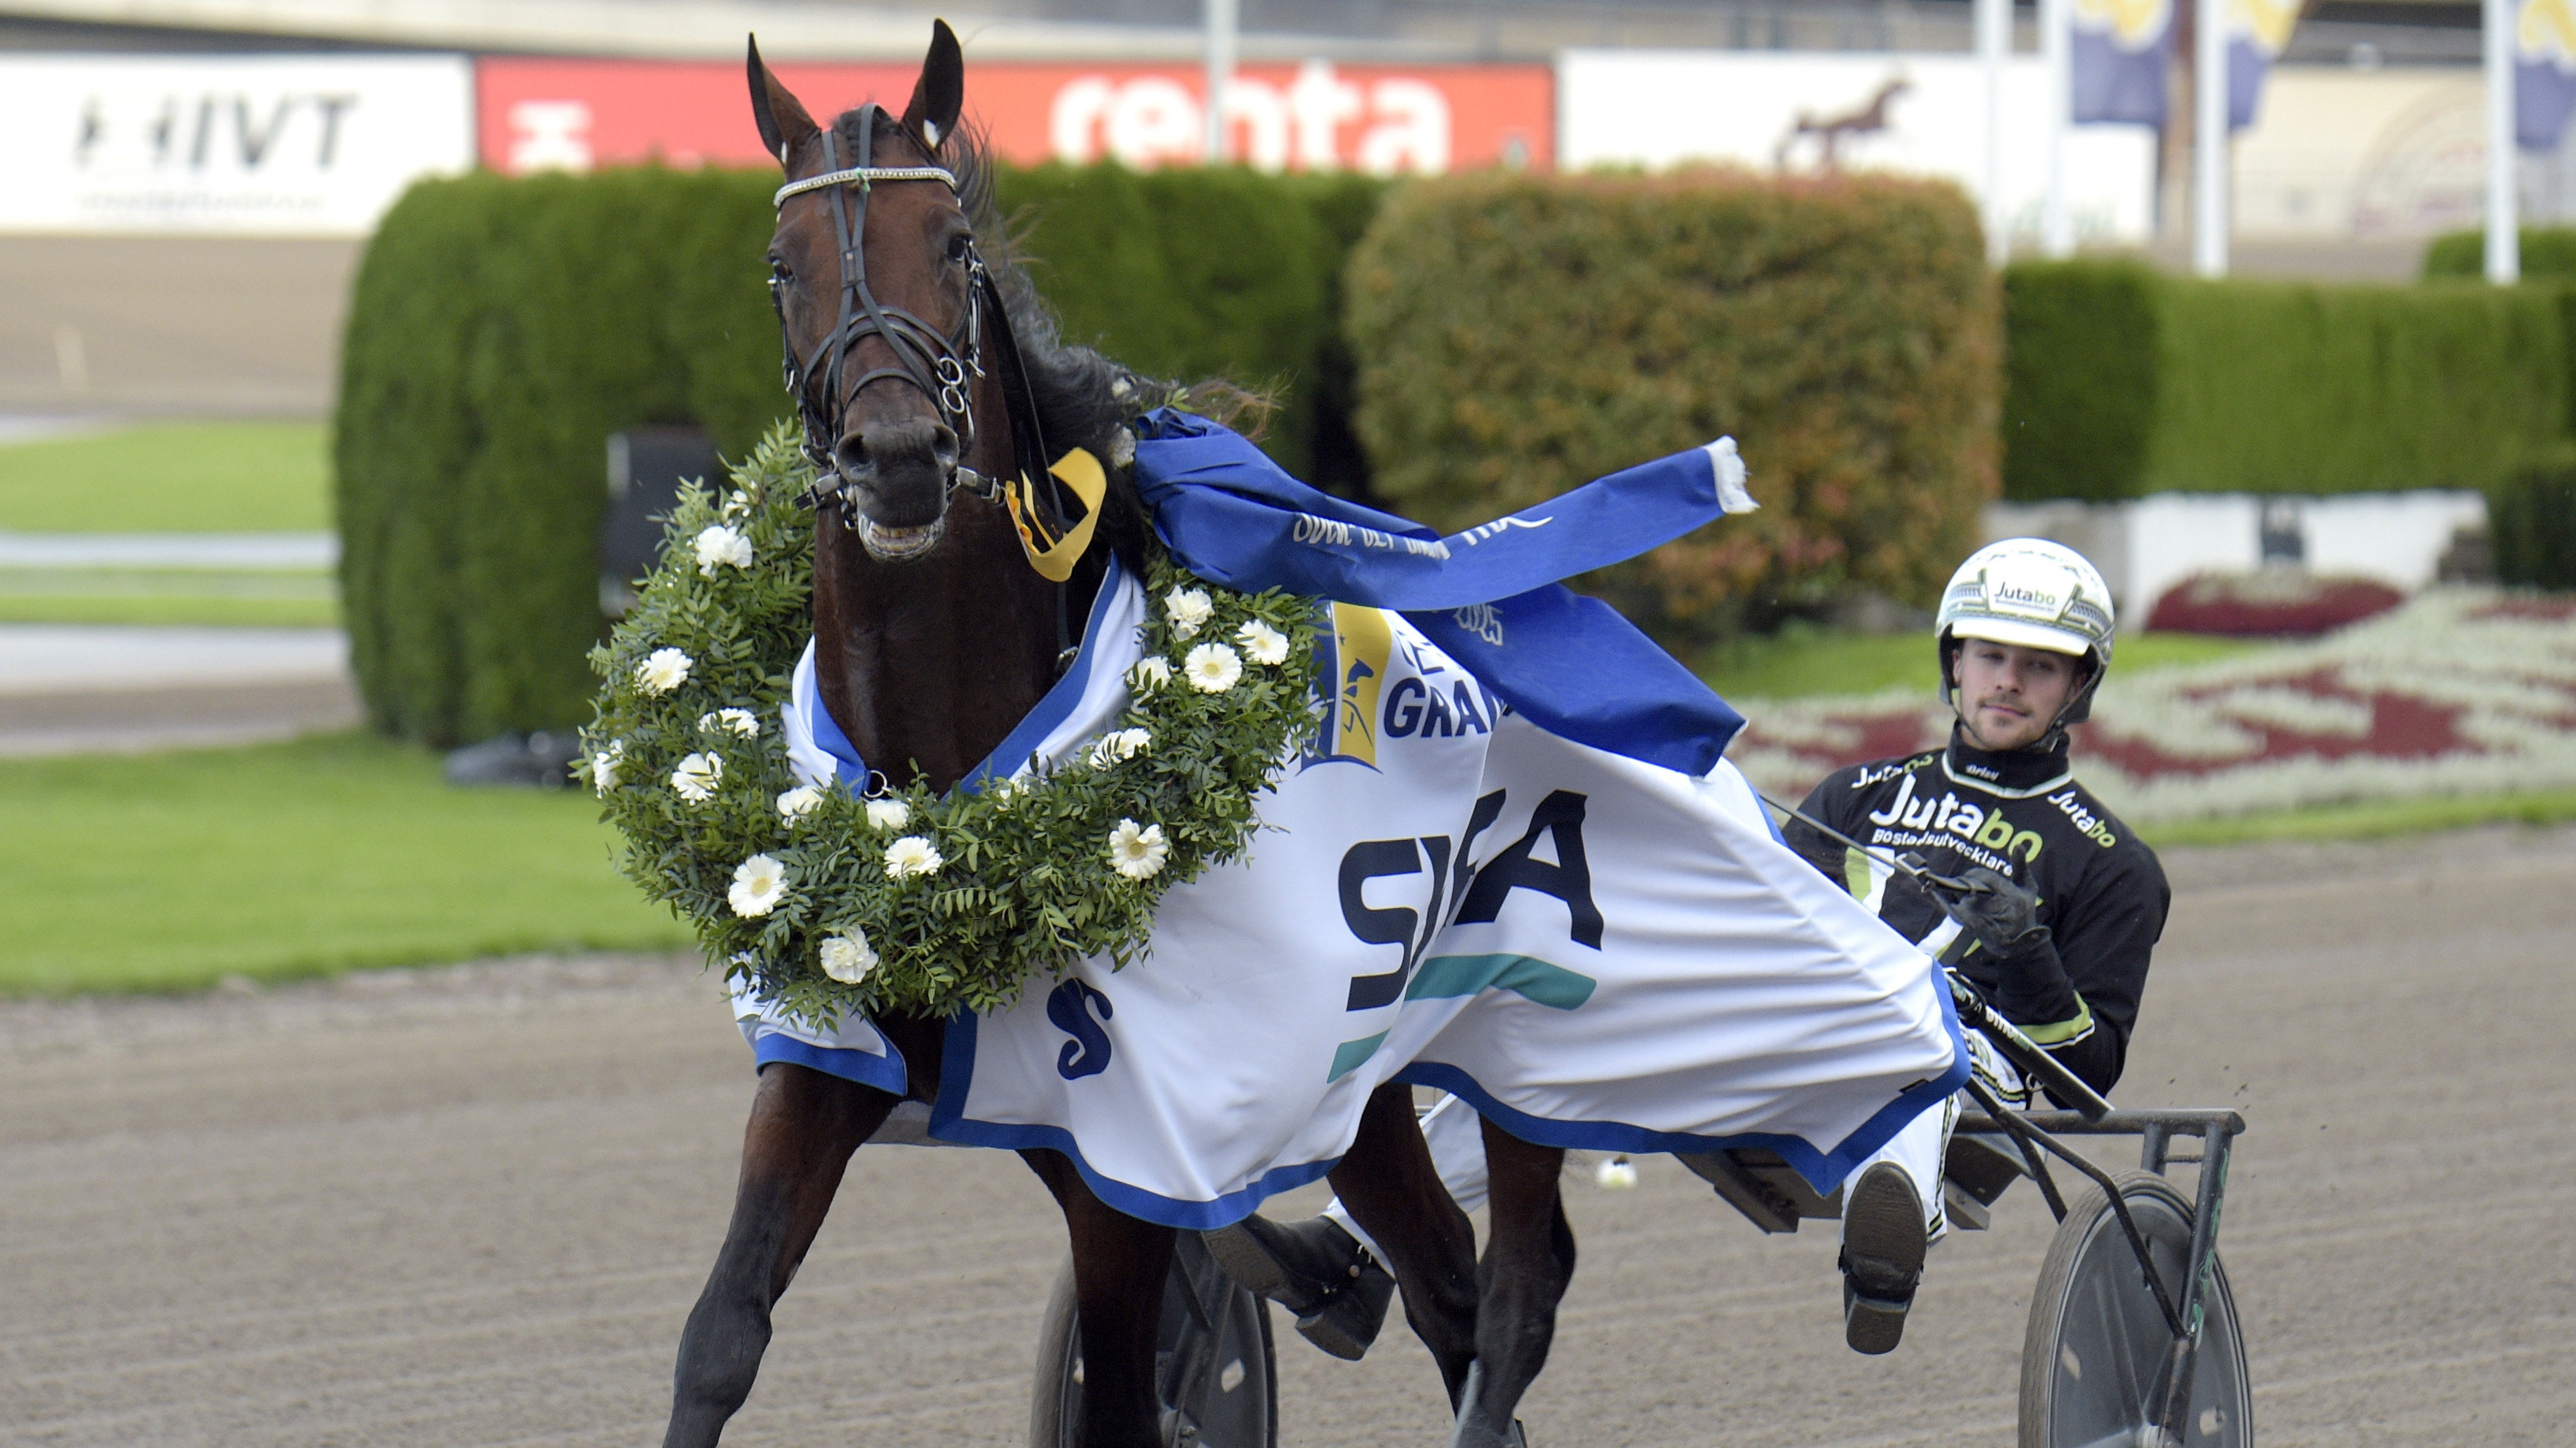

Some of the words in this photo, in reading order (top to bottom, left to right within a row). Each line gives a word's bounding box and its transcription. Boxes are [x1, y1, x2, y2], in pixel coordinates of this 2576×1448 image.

[1049, 57, 1454, 179] renta
[1994, 581, 2056, 605] Jutabo
[1384, 677, 1513, 738] GRA
[1869, 772, 2043, 864] Jutabo
[2047, 790, 2116, 848] Jutabo
